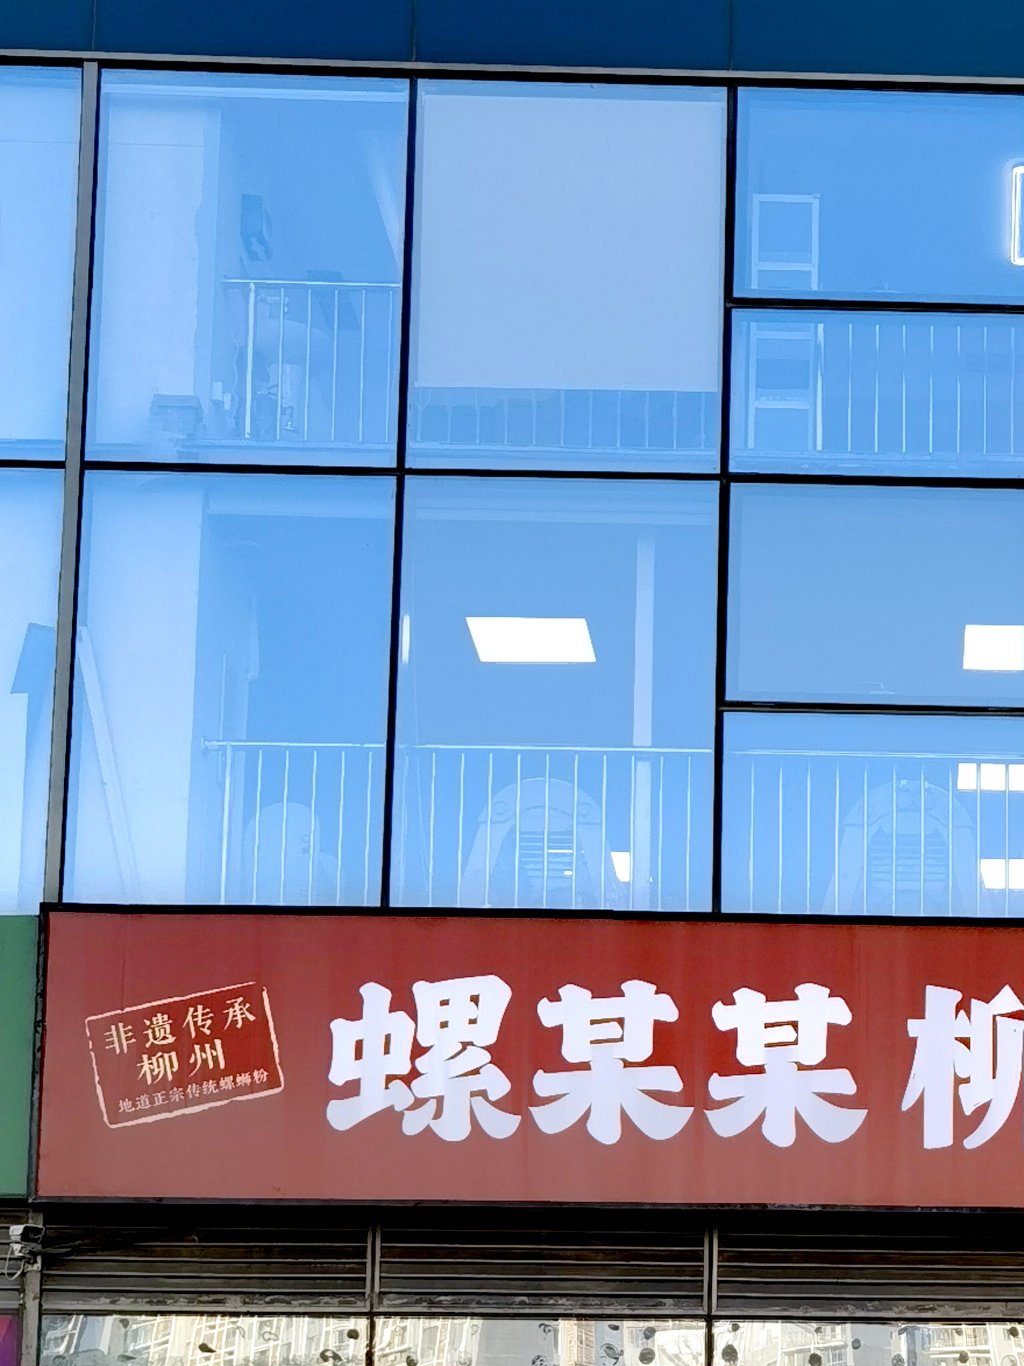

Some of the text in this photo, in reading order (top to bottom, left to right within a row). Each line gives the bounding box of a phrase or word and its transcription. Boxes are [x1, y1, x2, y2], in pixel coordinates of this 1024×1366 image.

[104, 996, 257, 1056] 非遗传承
[136, 1038, 226, 1086] 柳州
[326, 973, 868, 1148] 螺某某
[118, 1067, 270, 1114] 地道正宗传统螺蛳粉
